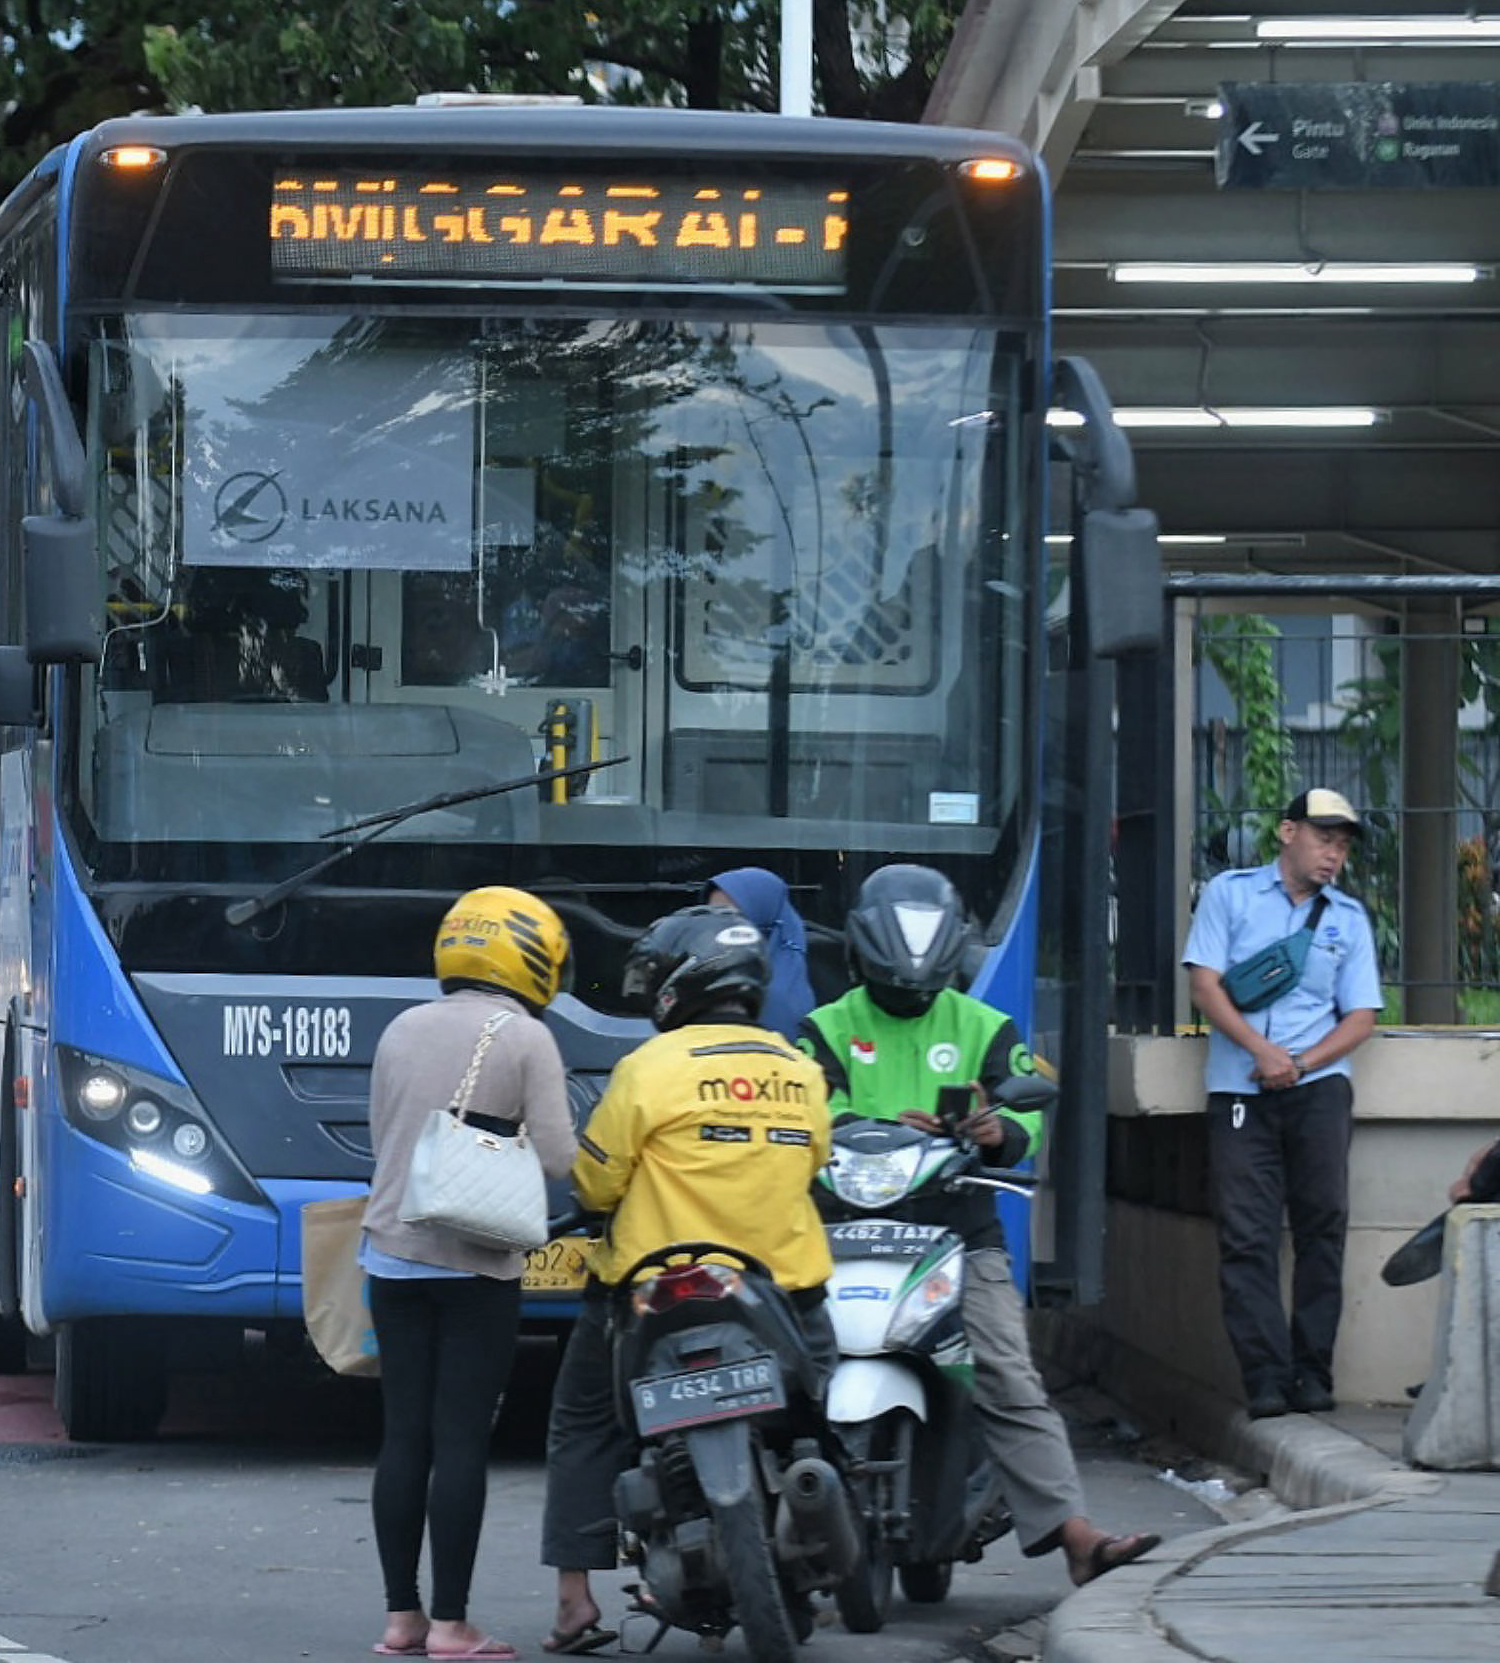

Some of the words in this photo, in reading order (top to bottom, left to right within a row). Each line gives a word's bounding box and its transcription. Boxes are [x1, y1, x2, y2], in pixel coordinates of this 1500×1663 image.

[1292, 118, 1346, 138] Pintu
[302, 498, 447, 525] LAKSANA
[223, 1004, 351, 1057] MYS-18183
[698, 1070, 810, 1105] maxim
[641, 1388, 656, 1409] B
[669, 1374, 724, 1400] 4634
[729, 1364, 771, 1389] TRR
